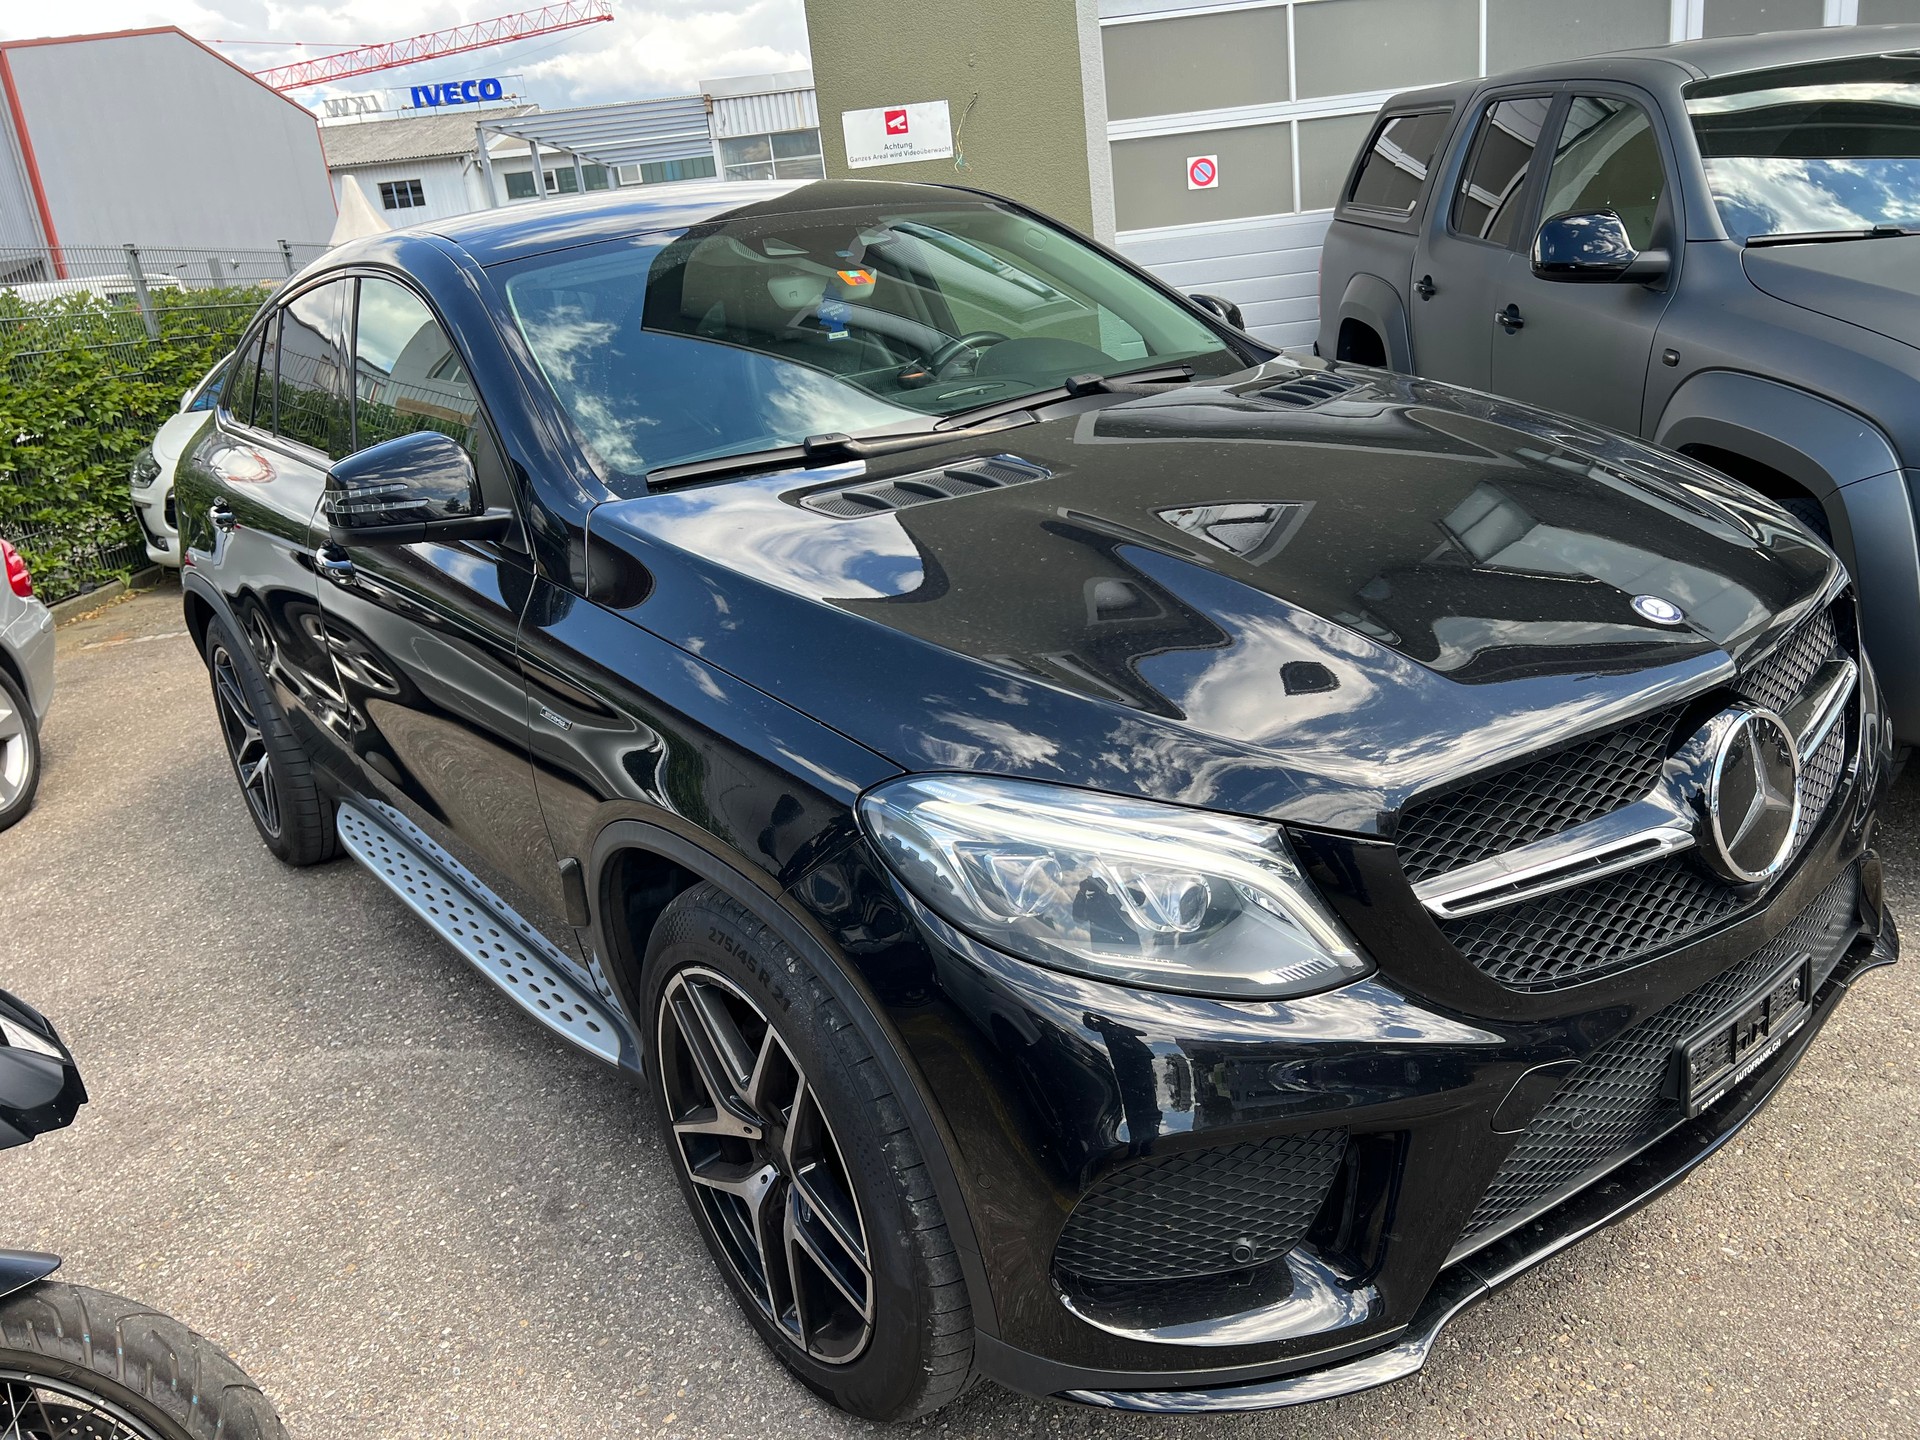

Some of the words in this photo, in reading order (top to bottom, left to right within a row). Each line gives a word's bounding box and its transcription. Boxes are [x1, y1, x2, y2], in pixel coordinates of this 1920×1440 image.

[410, 78, 503, 109] IVECO
[872, 151, 888, 160] Areal
[889, 150, 902, 158] wird
[904, 146, 952, 156] Videoüberwacht
[884, 142, 913, 151] Achtung
[708, 926, 758, 974] 275/45
[758, 968, 771, 989] R
